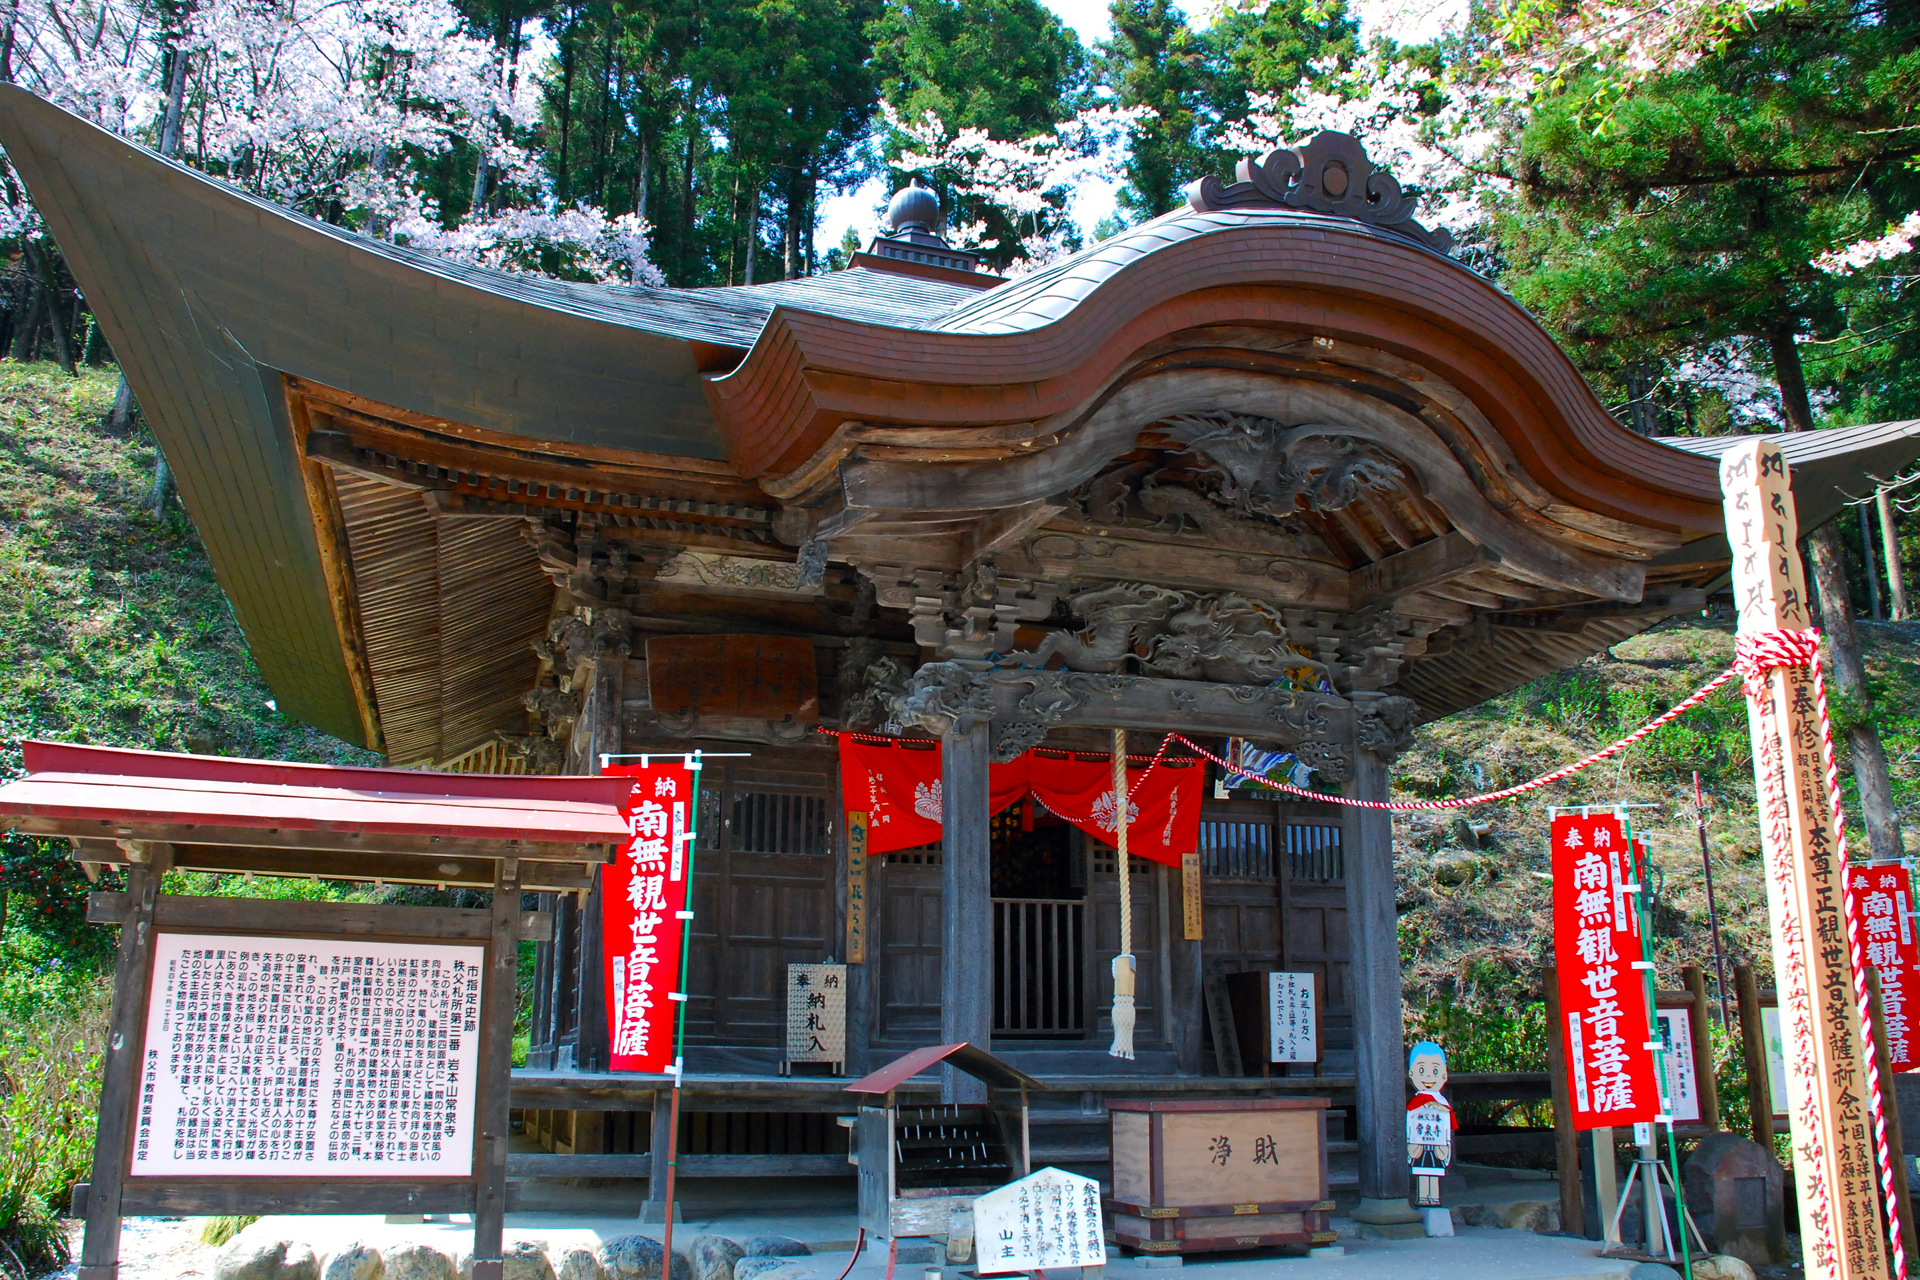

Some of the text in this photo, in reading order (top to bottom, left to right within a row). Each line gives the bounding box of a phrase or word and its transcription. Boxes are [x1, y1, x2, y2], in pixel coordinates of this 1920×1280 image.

[1564, 826, 1611, 850] 奉納
[1852, 874, 1897, 889] 奉納
[618, 799, 669, 1057] 南無観世音菩薩
[326, 956, 341, 1042] を持っております。
[464, 966, 479, 1032] 市指定史跡
[796, 972, 839, 989] 奉納
[1573, 851, 1637, 1114] 南無観世音菩薩
[1861, 891, 1912, 1064] 南無観世音菩薩
[170, 949, 191, 1080] たことを物語っております。
[806, 992, 827, 1052] 納札入
[444, 960, 466, 1138] 秩父札所第三番 岩本山常泉寺
[137, 1049, 158, 1161] 秩父市教育委員会指定
[1416, 1122, 1442, 1138] 常泉寺
[1208, 1134, 1279, 1167] 浄財
[998, 1228, 1016, 1258] 山主
